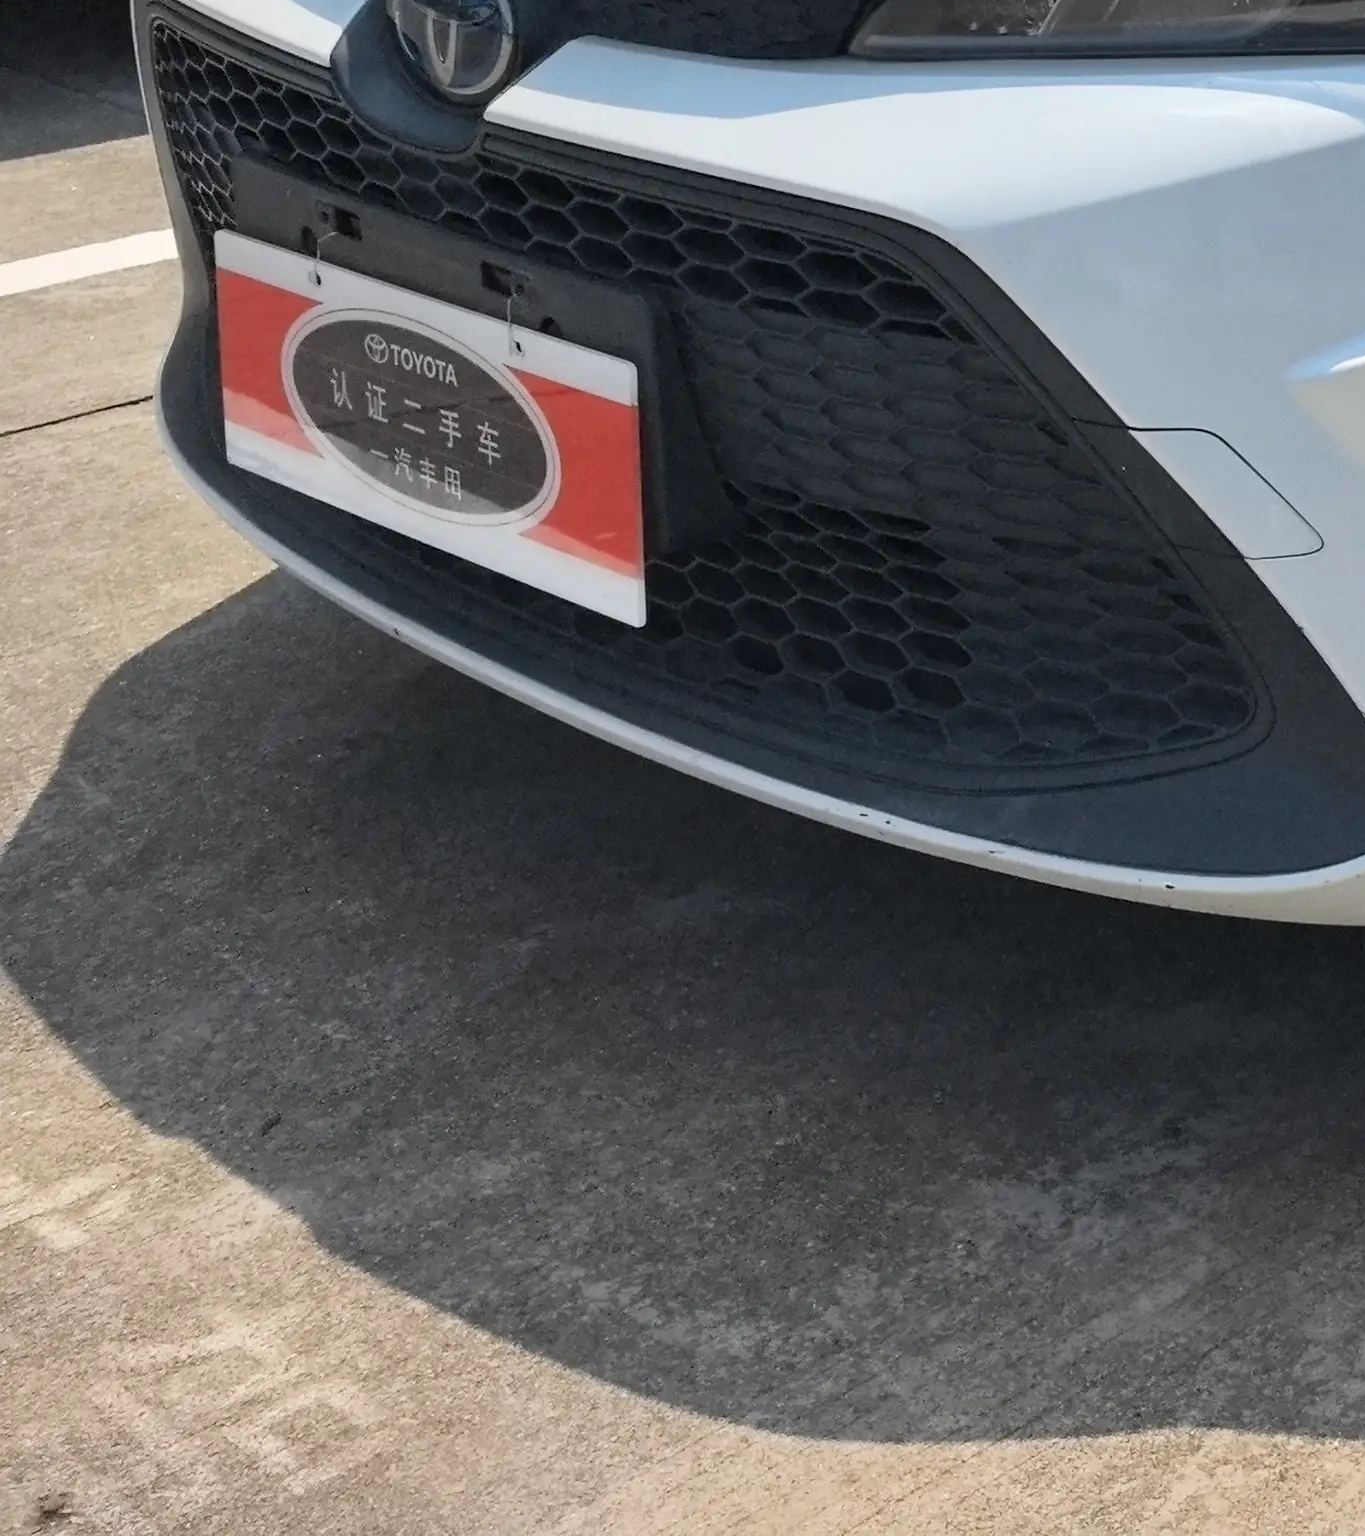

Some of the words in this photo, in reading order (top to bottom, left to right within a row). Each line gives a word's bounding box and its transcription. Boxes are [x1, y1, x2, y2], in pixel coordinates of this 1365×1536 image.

[389, 344, 459, 388] TOYOTA
[328, 366, 502, 467] 认证二手车
[369, 447, 463, 501] 一汽丰田
